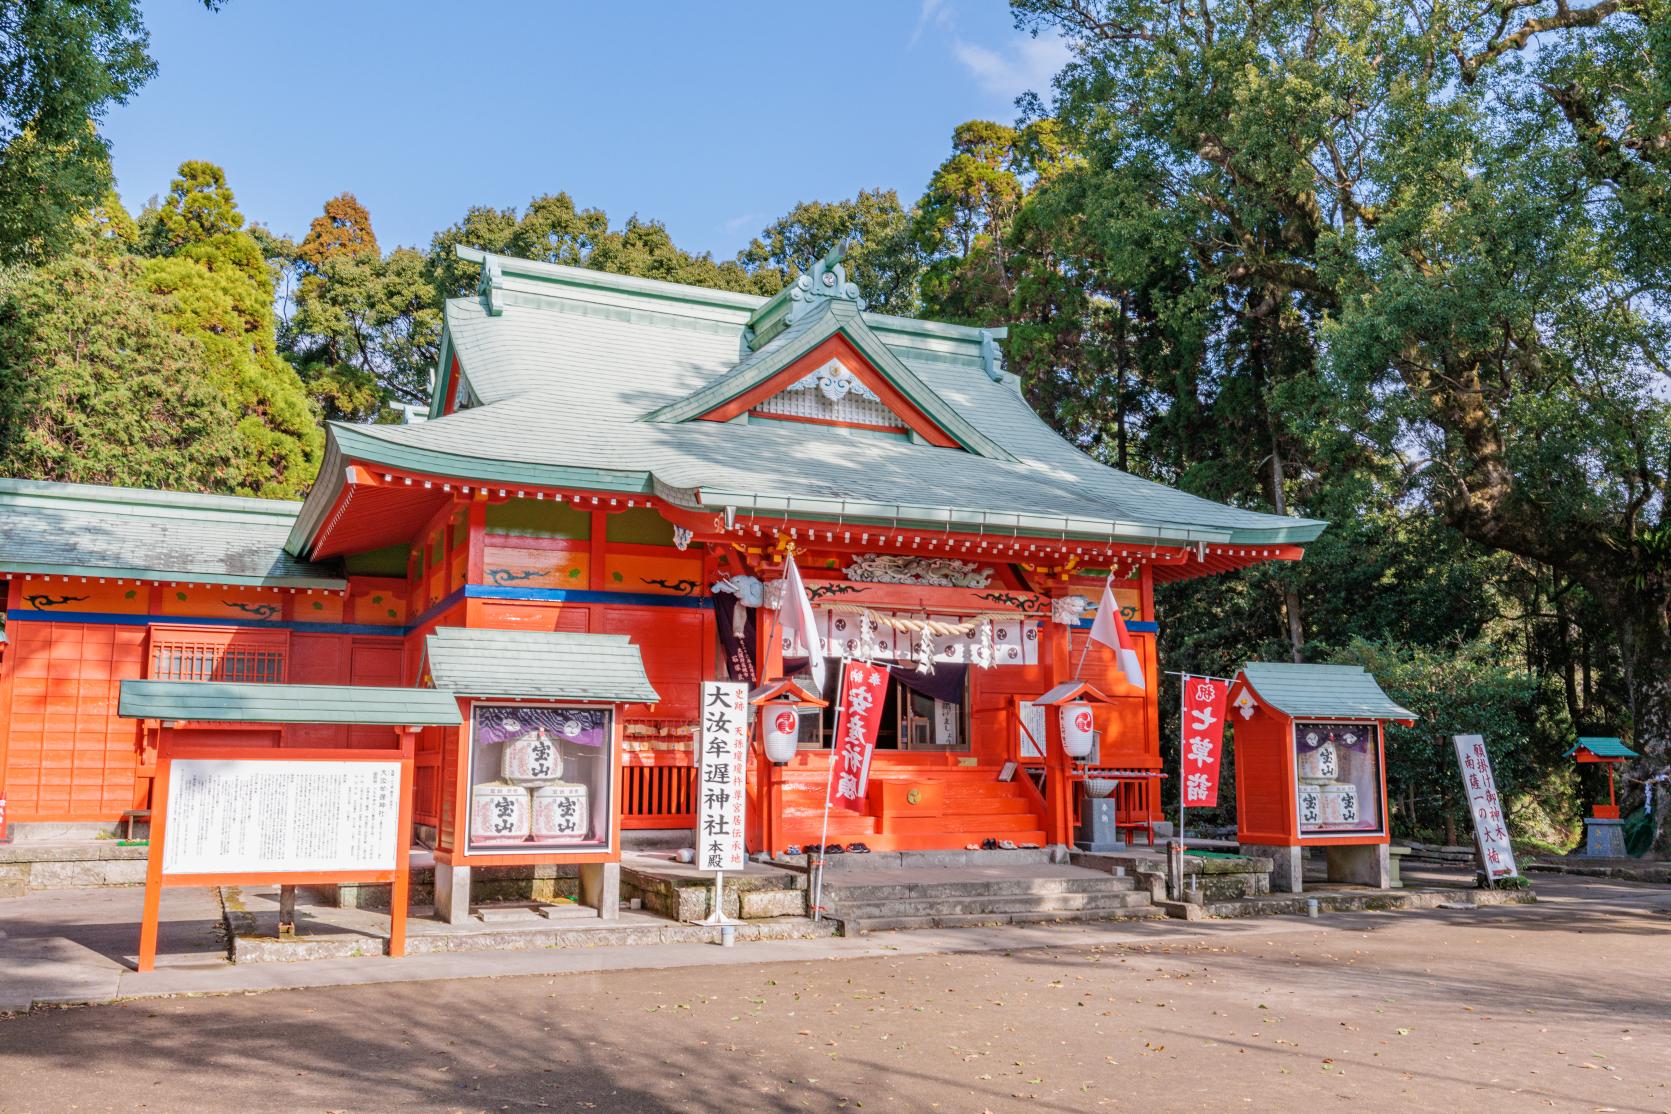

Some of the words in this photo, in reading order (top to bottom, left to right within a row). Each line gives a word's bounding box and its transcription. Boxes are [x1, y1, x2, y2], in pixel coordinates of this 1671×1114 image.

[734, 688, 745, 711] 史跡
[531, 741, 551, 777] 宝山
[1319, 748, 1334, 776] 宝山
[494, 797, 515, 833] 宝山
[558, 797, 577, 833] 宝山
[1303, 793, 1318, 822] 宝山
[1341, 792, 1356, 821] 宝山
[1464, 753, 1500, 864] 南薩一の大楠
